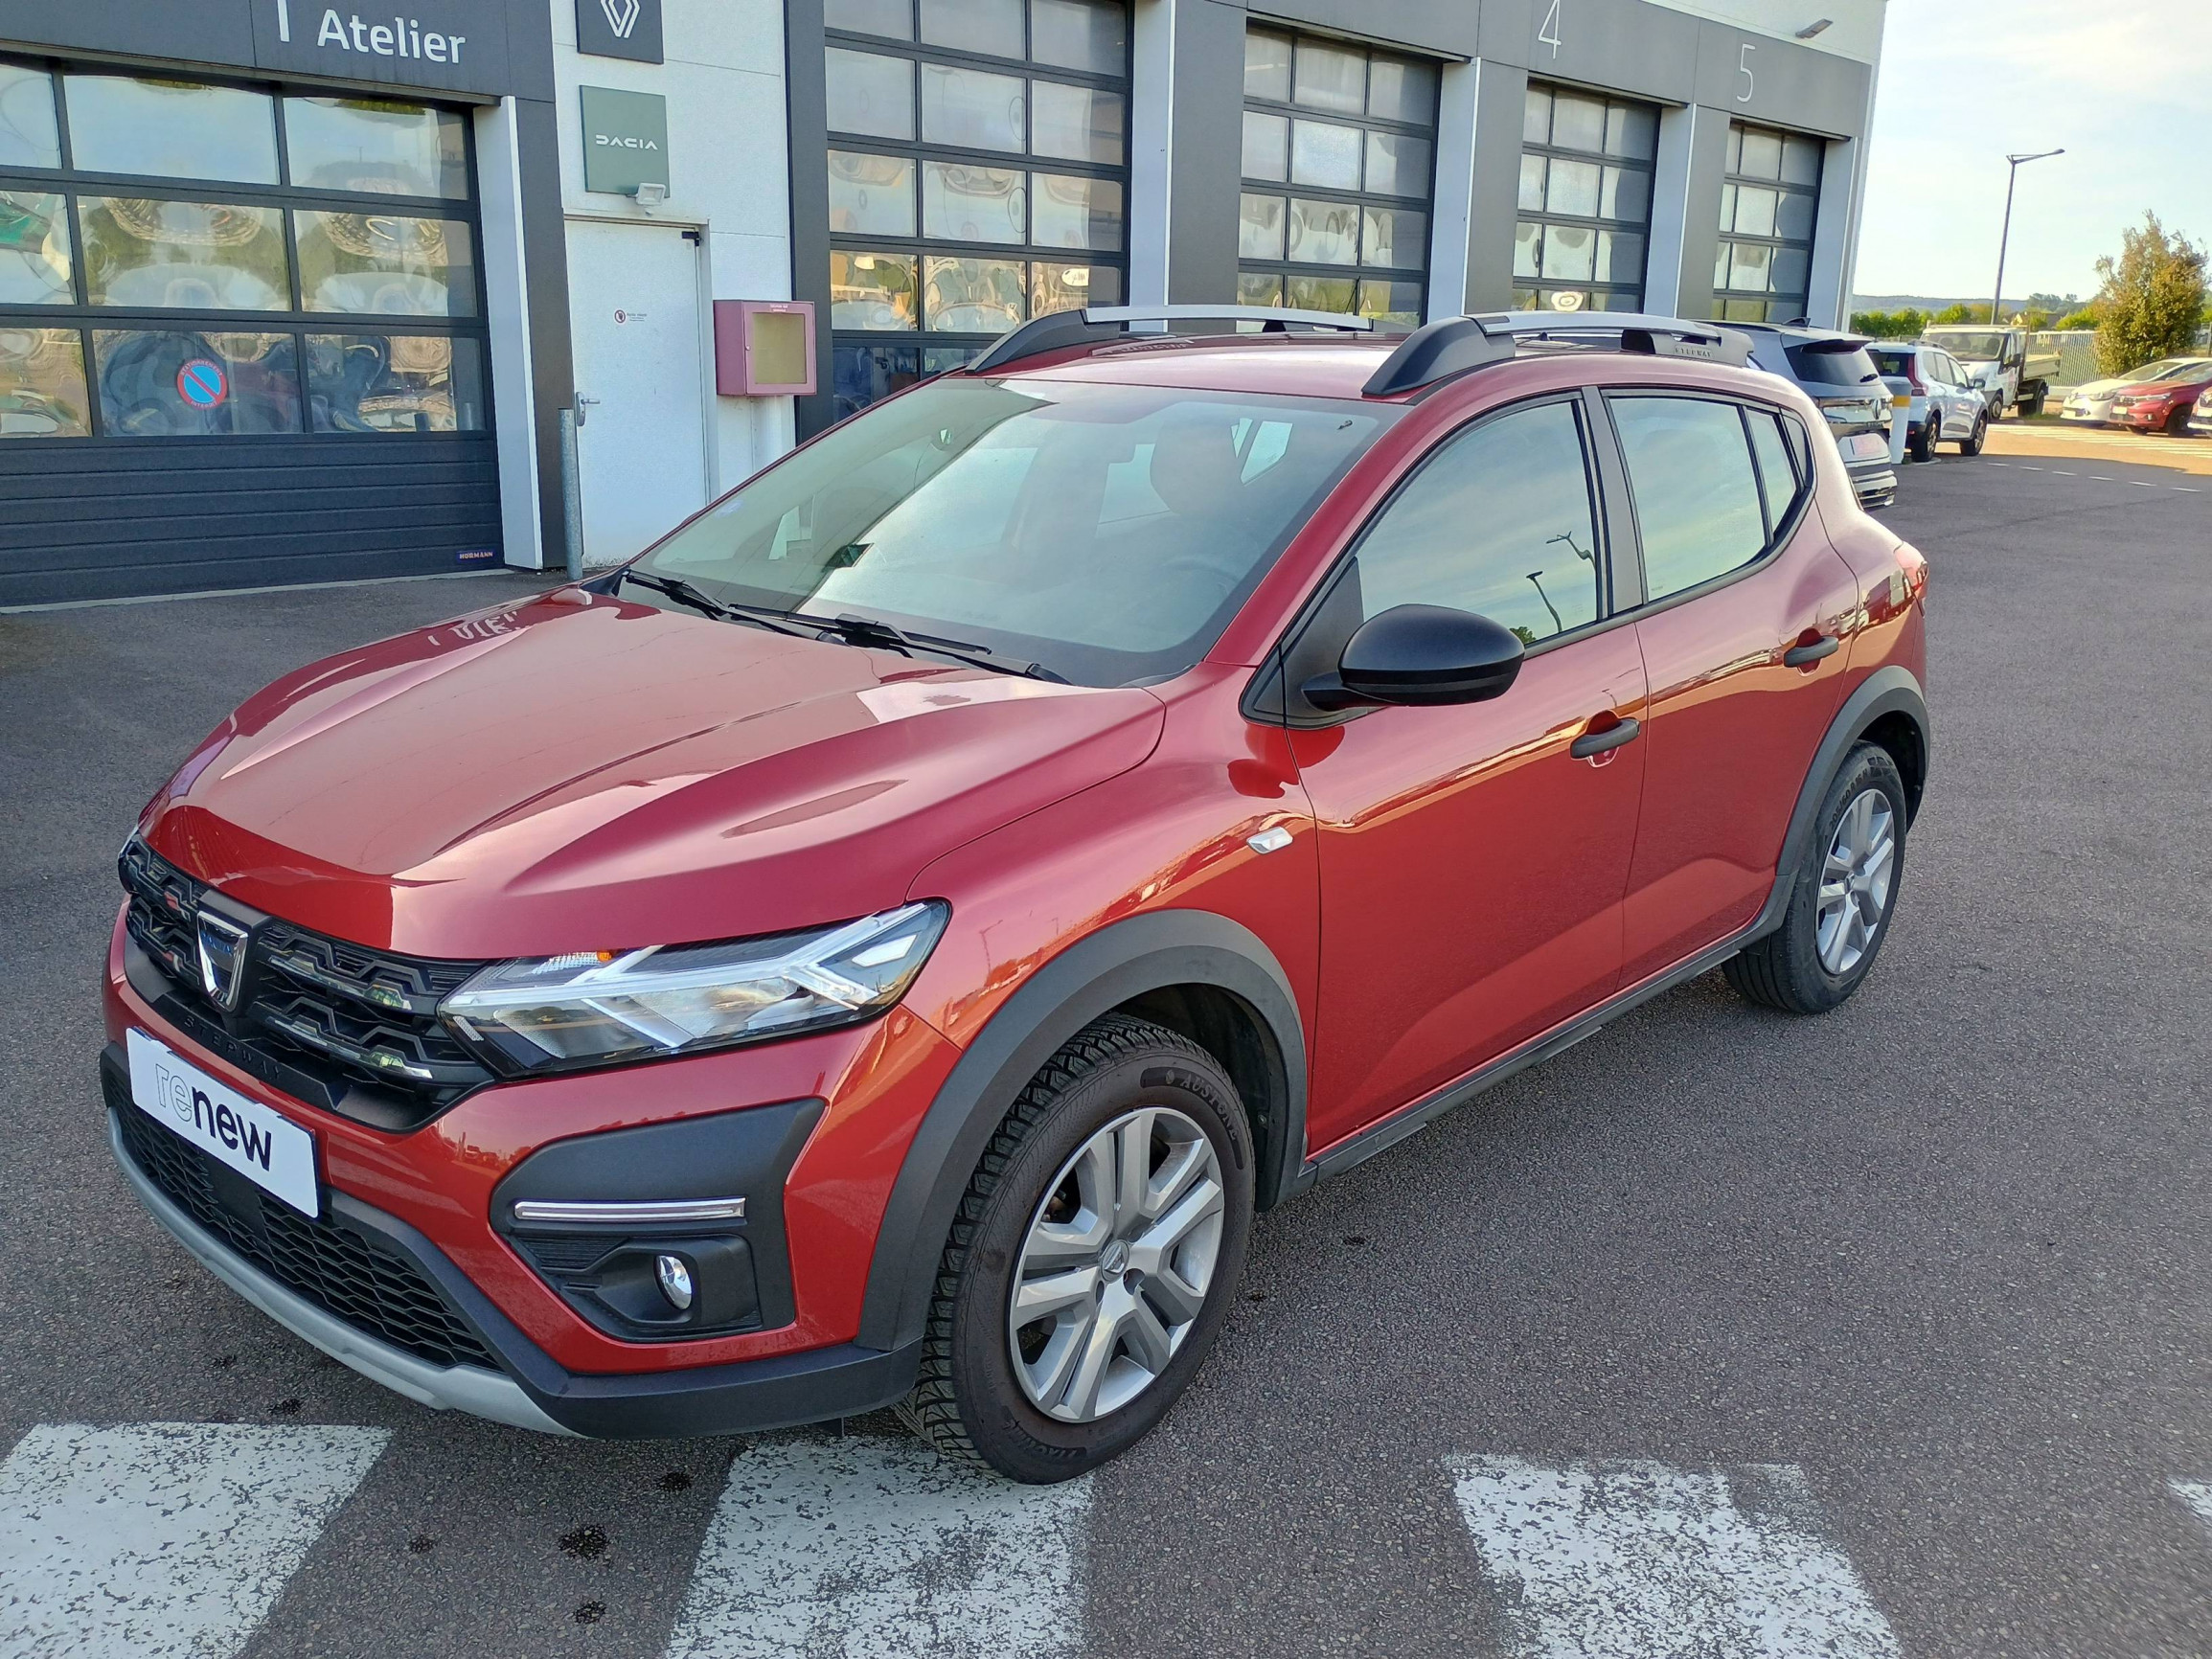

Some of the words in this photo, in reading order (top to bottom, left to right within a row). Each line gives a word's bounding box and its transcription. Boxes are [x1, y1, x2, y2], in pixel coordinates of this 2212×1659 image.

[317, 9, 466, 63] Atelier
[1539, 0, 1562, 59] 4
[1736, 43, 1756, 102] 5
[595, 134, 658, 150] DACIA
[184, 1014, 281, 1080] STEPWAY
[155, 1063, 272, 1172] renew
[1179, 1073, 1239, 1141] AUSTONE
